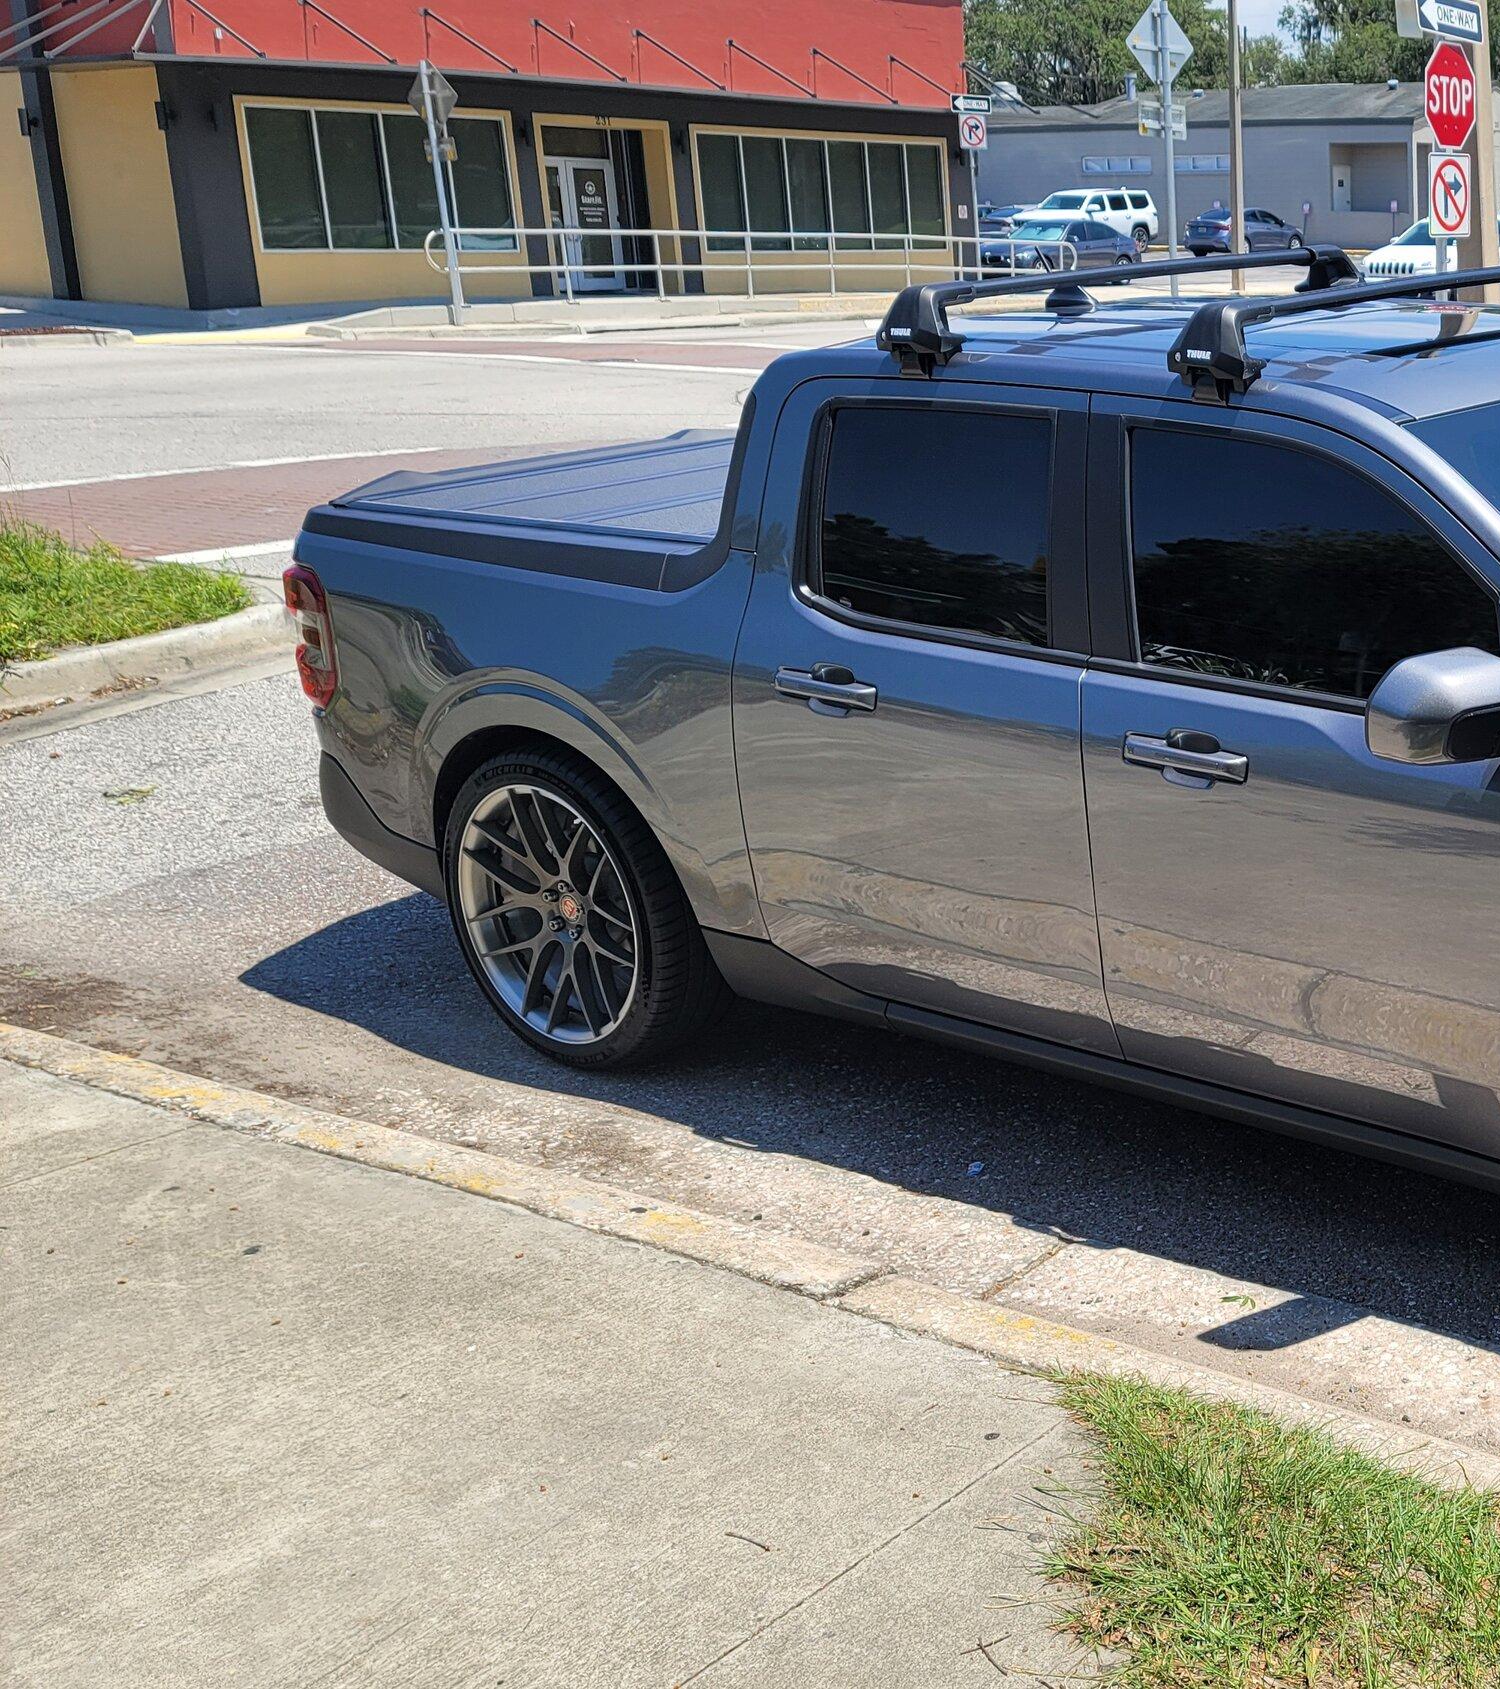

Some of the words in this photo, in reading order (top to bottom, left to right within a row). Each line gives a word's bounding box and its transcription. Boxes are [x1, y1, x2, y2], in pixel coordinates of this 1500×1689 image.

[1429, 74, 1472, 117] STOP
[595, 115, 611, 126] 231
[890, 327, 912, 336] THULE
[1186, 349, 1212, 360] THULE
[485, 763, 534, 781] MICHELIN
